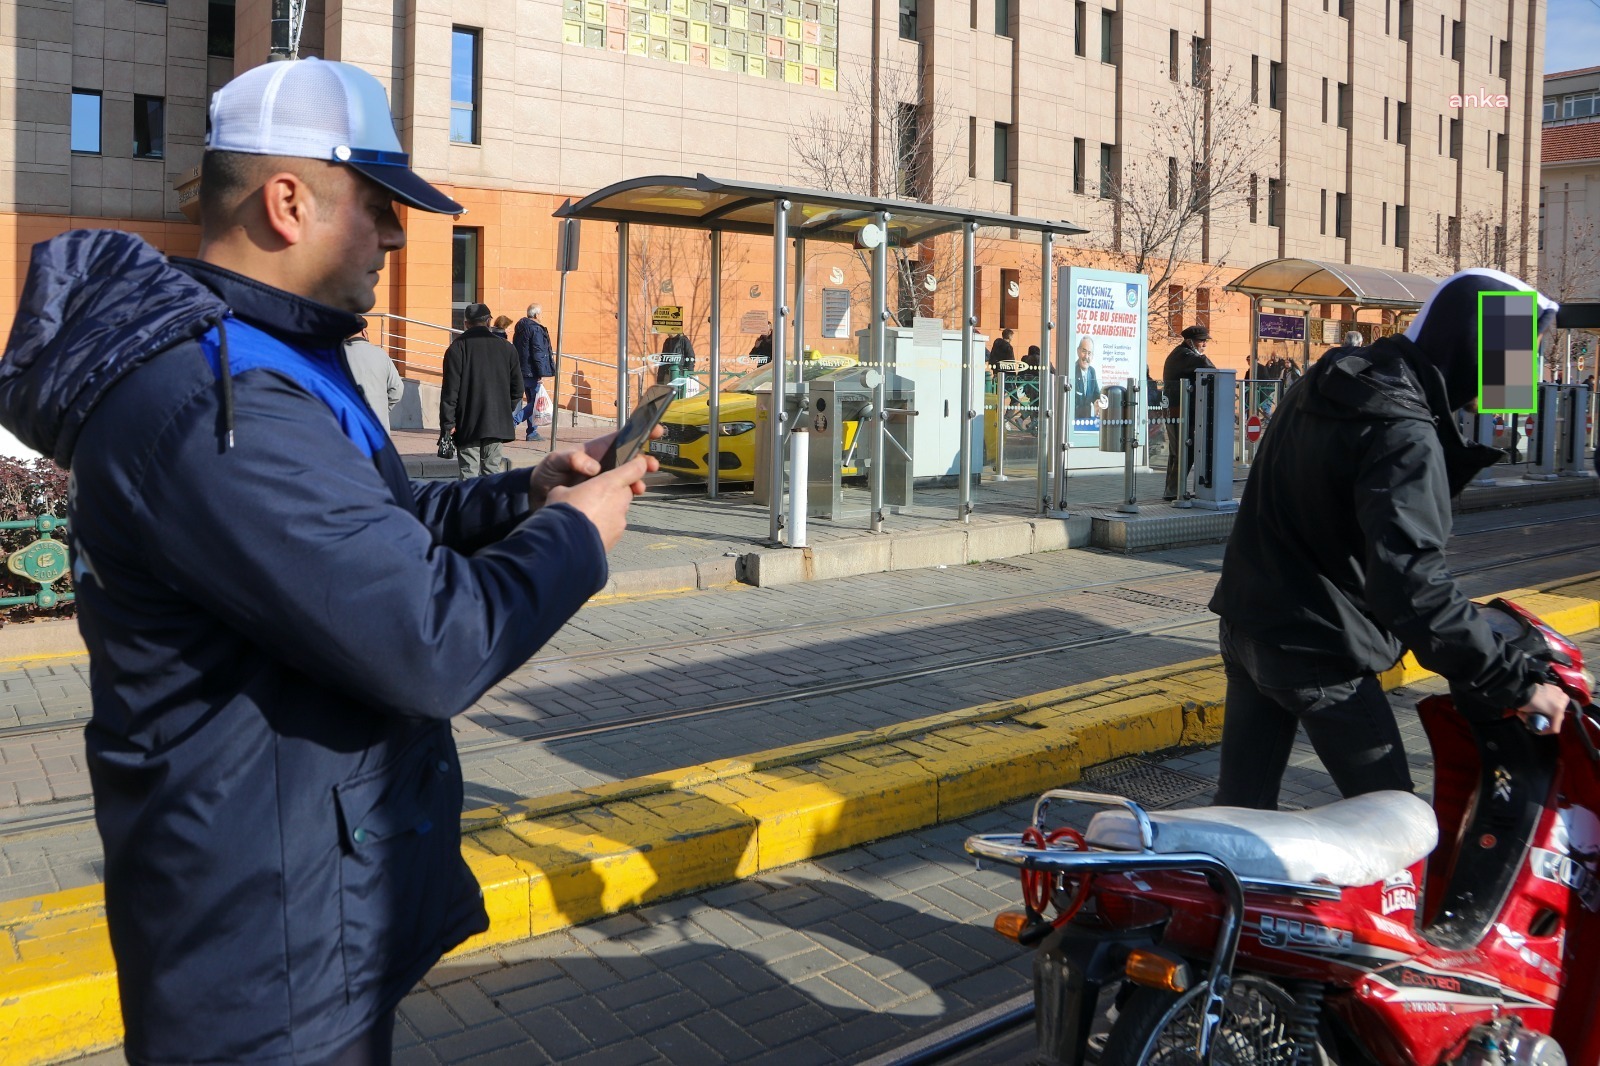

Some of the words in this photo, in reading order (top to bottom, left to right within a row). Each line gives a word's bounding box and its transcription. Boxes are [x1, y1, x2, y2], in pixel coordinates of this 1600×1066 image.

[1089, 311, 1099, 321] DE
[1100, 311, 1110, 322] BU
[1076, 321, 1091, 334] SÖZ
[34, 569, 58, 578] 2004
